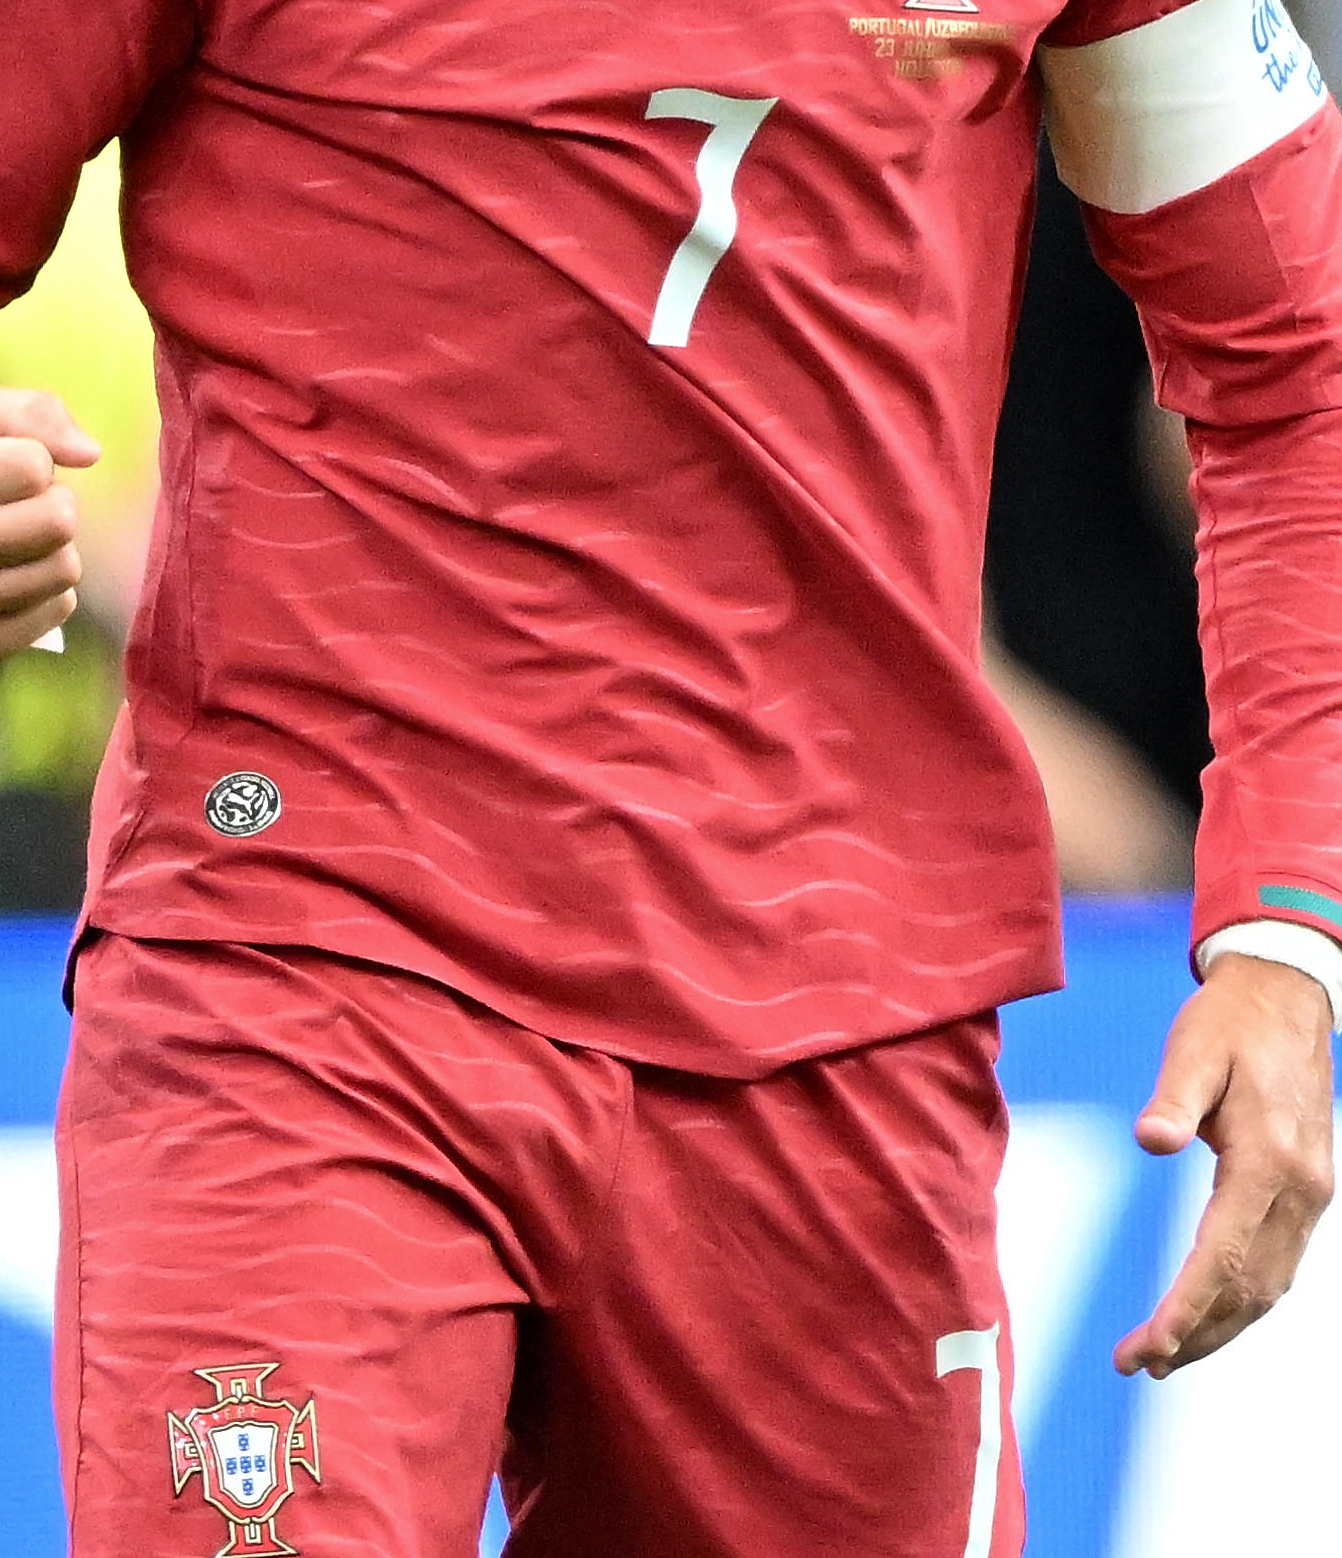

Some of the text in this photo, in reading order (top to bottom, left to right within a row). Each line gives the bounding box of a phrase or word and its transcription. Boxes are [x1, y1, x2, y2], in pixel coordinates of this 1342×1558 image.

[874, 38, 895, 58] 23
[645, 87, 779, 347] 7
[936, 1320, 1001, 1558] 7
